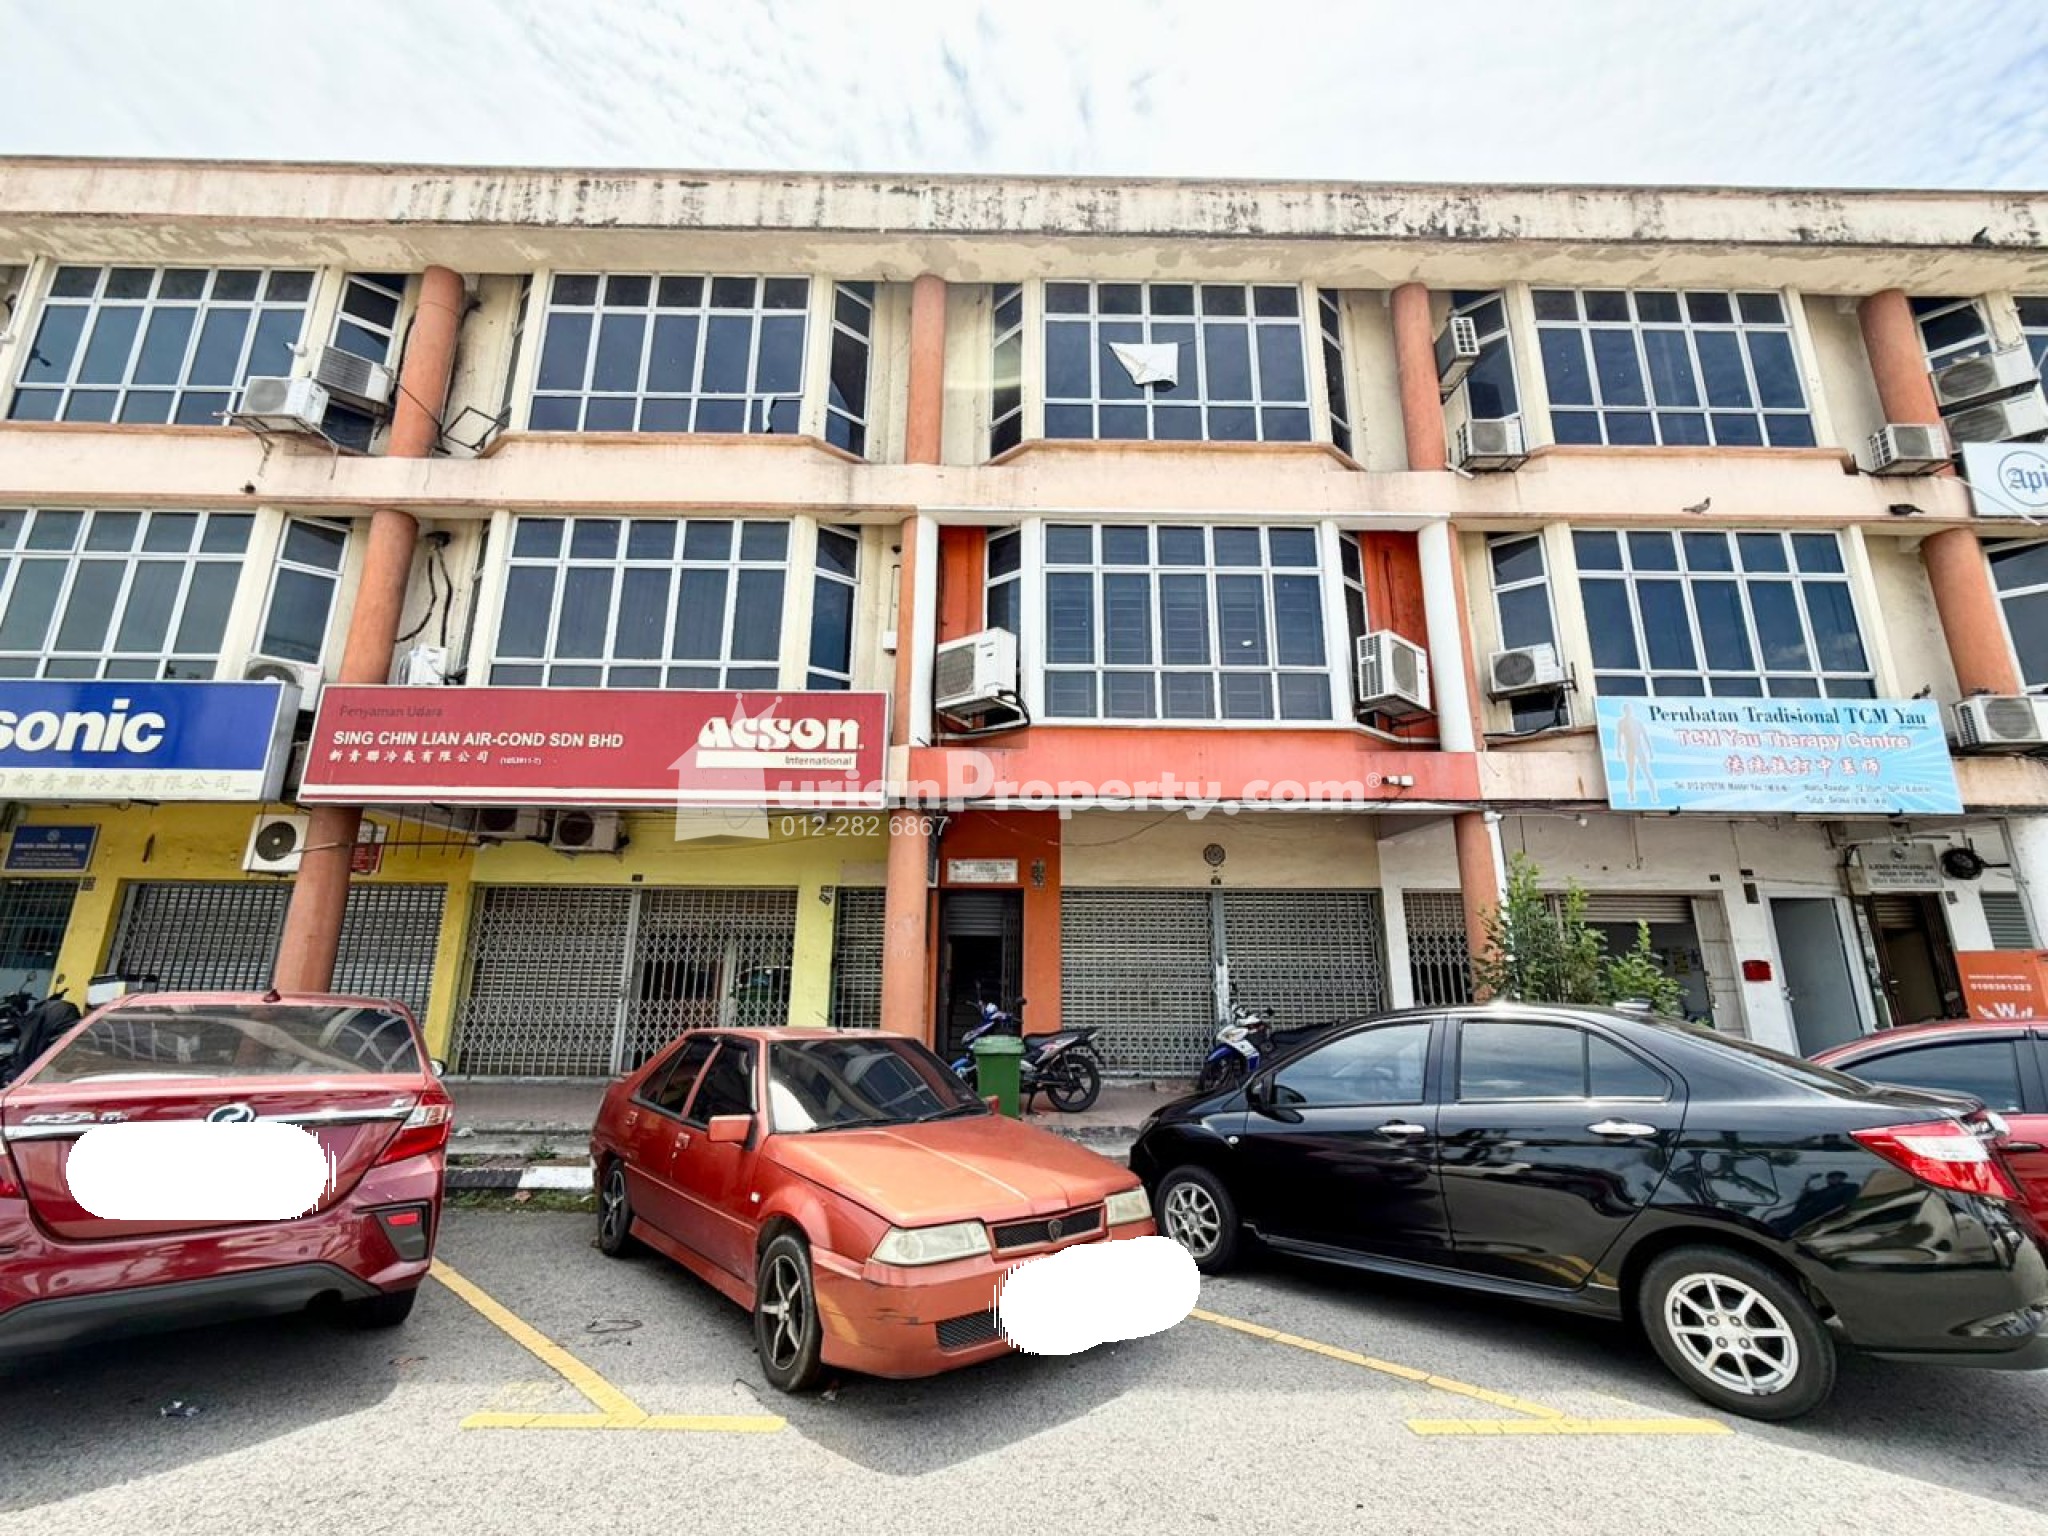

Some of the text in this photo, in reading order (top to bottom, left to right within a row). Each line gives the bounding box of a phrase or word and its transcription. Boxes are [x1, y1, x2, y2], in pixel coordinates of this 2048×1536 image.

[408, 706, 443, 718] Udara
[1649, 705, 1926, 724] Perubatan Tradisional TCM Yau
[332, 731, 623, 747] SING CHIN LIAN AIR-COND SDN BHD
[1675, 729, 1910, 752] TCM Yau Therapy Centre
[785, 756, 852, 766] International
